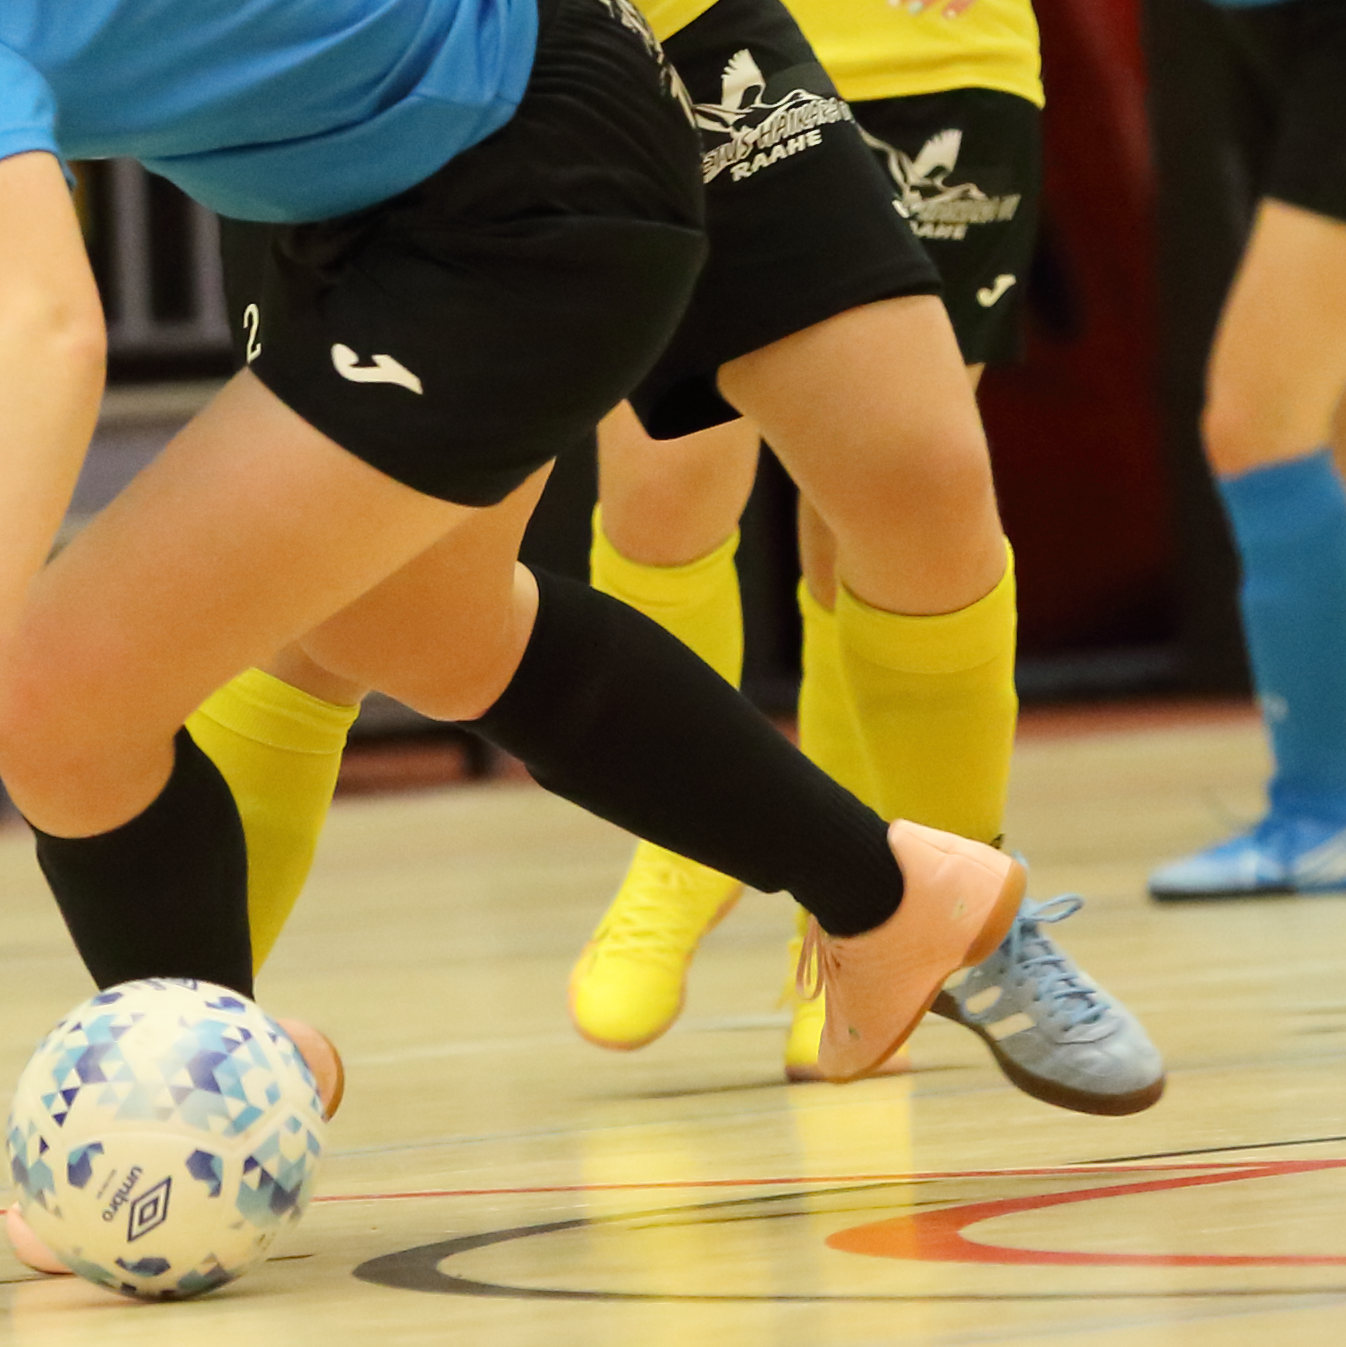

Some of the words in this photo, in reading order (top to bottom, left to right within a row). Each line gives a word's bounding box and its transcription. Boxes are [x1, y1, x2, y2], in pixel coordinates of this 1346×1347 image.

[730, 128, 823, 183] RAAHE
[243, 303, 262, 365] 2
[101, 1165, 144, 1223] umbro
